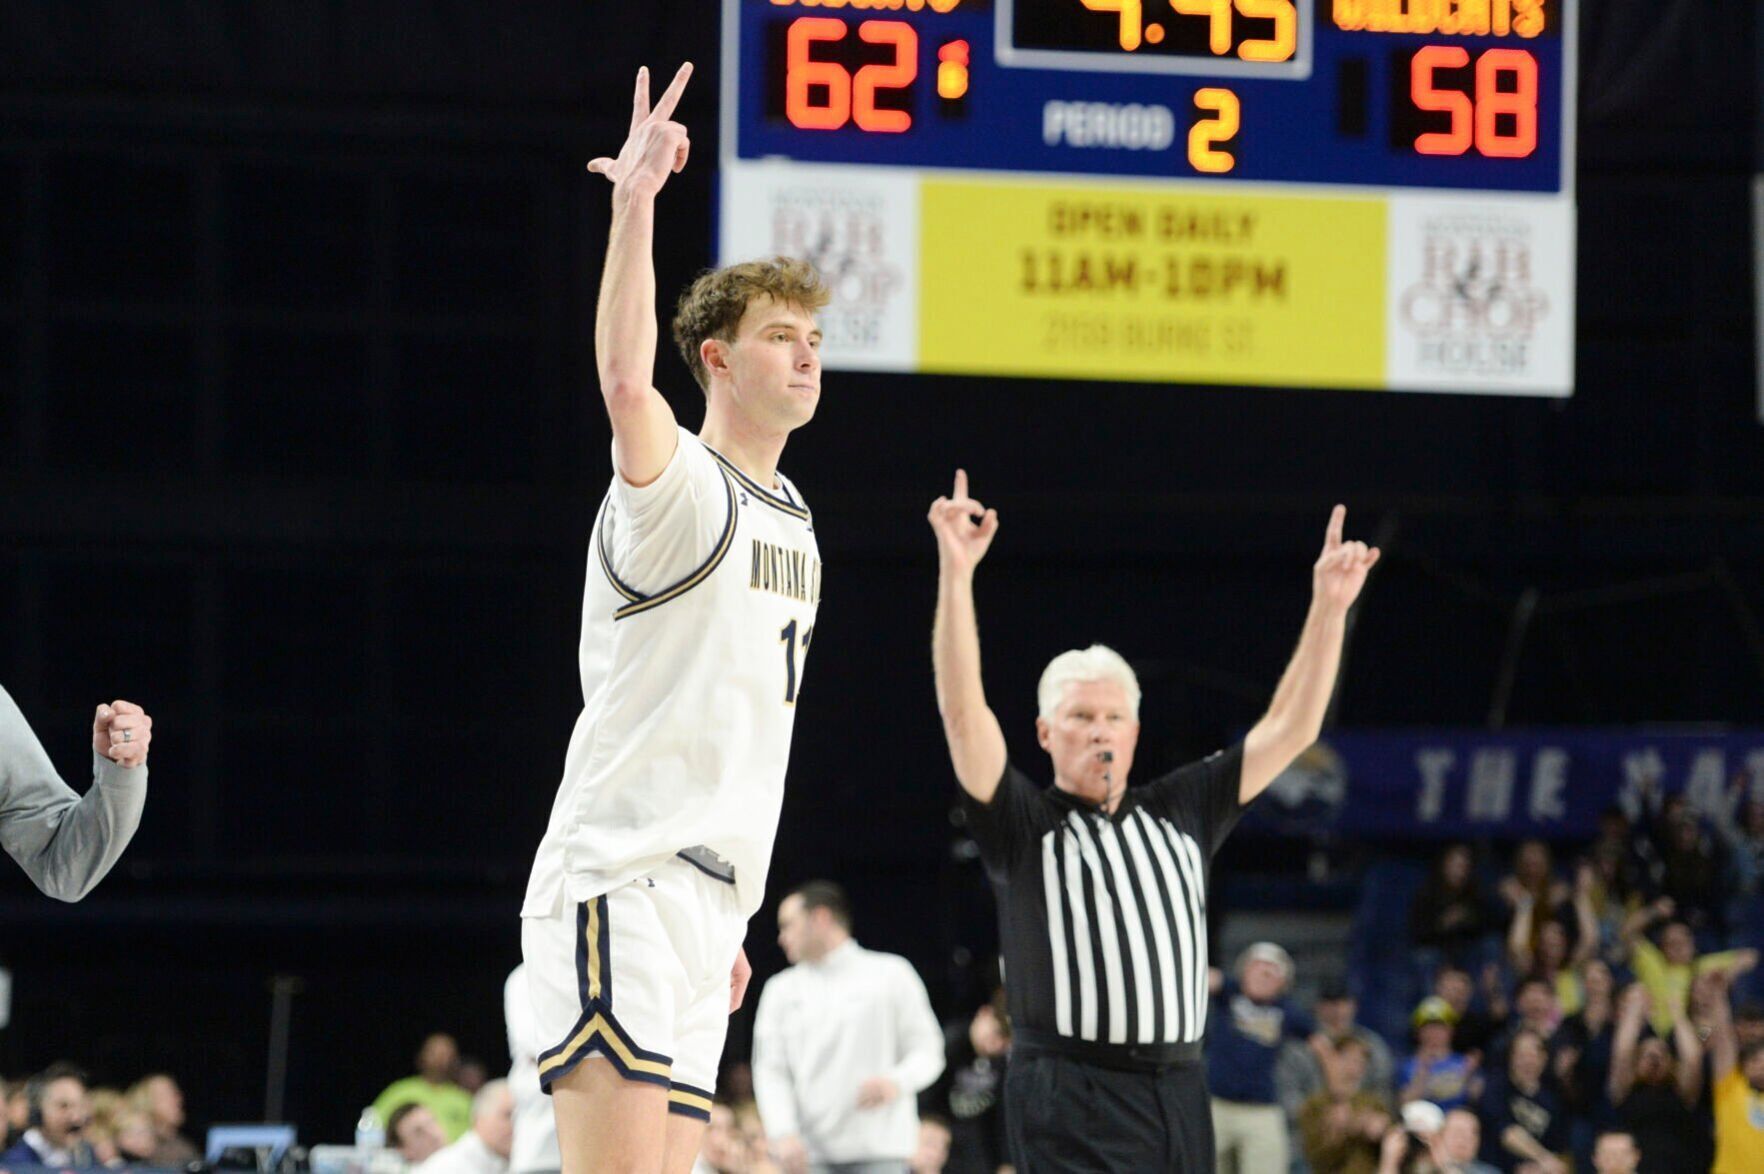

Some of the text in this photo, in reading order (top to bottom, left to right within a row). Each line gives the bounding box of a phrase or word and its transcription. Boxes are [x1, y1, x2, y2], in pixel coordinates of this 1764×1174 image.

[786, 16, 918, 131] 62
[1411, 46, 1537, 157] 58
[1043, 99, 1174, 151] PERIOD
[1188, 88, 1240, 172] 2
[1050, 203, 1255, 246] OPEN DAILY
[750, 539, 806, 601] MONTANA
[1416, 748, 1568, 823] THE
